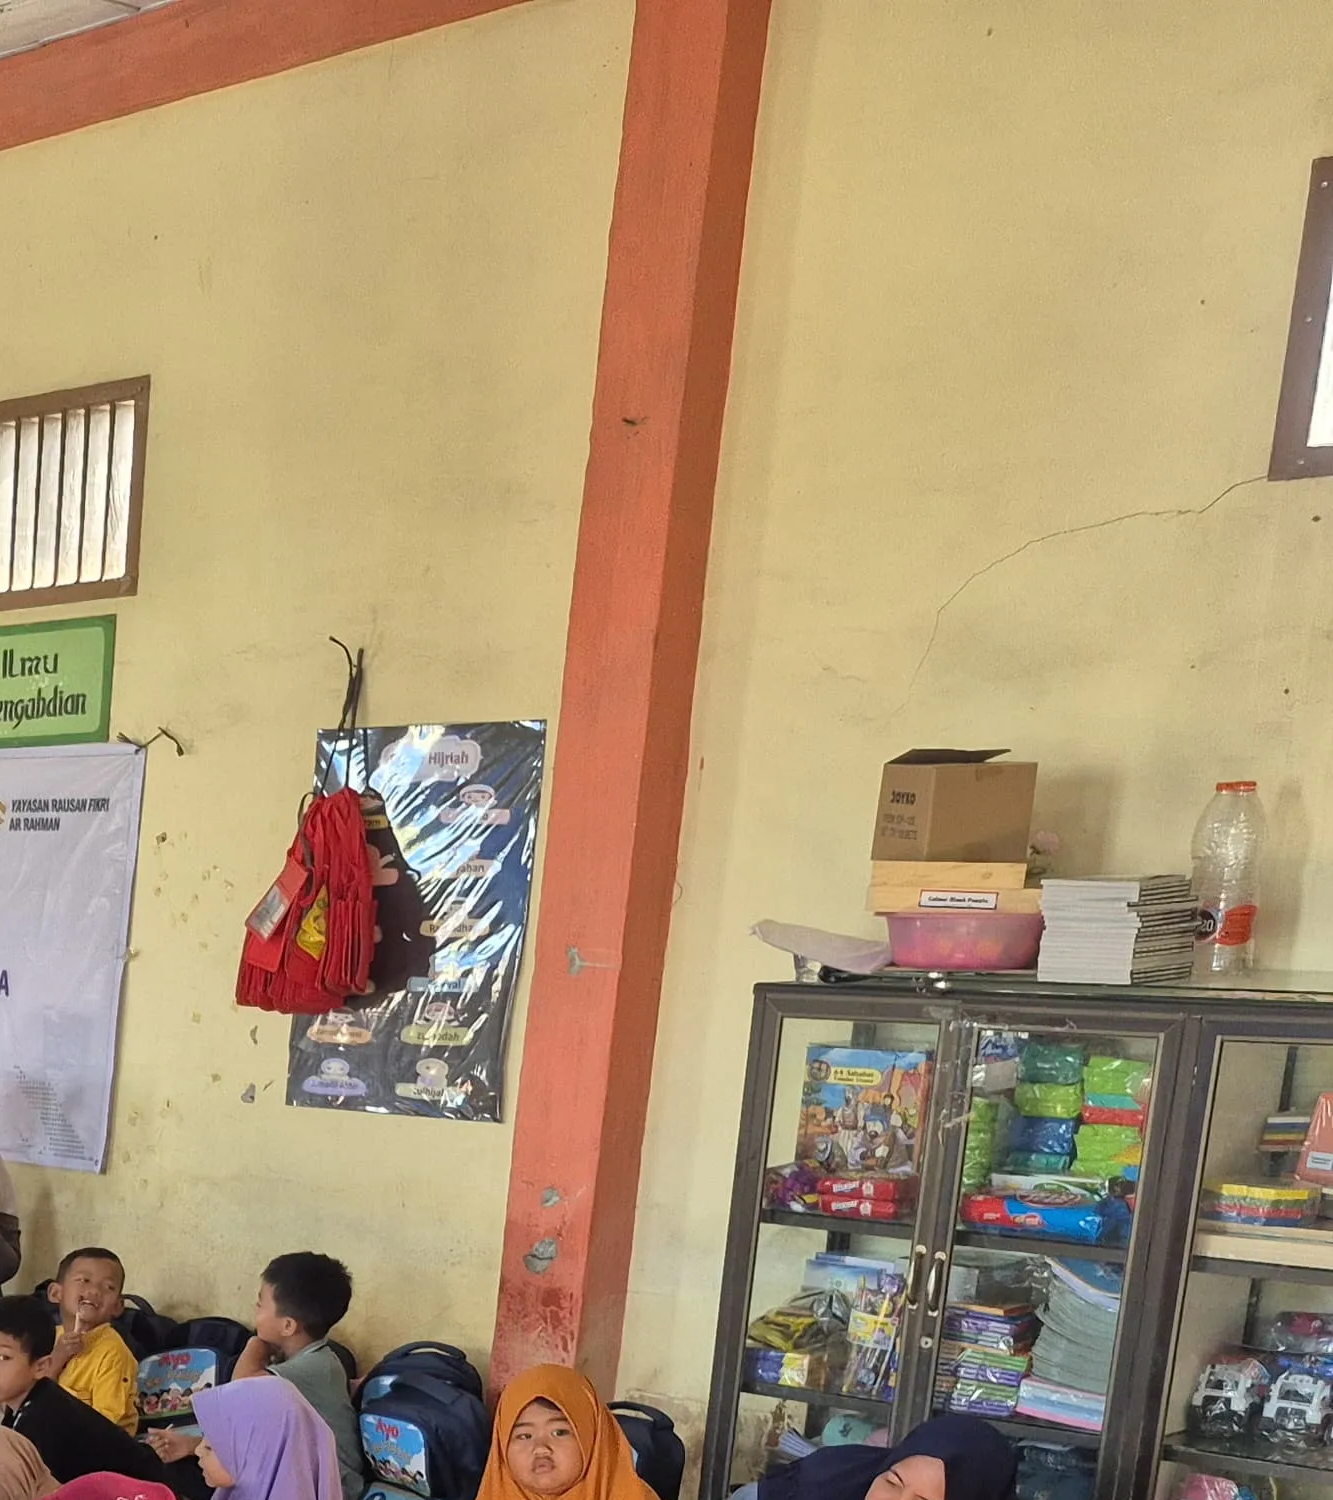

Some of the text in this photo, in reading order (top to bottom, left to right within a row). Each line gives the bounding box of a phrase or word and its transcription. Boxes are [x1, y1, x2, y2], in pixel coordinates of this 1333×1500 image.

[428, 750, 469, 767] Hijriah
[12, 798, 110, 812] YAYASAN RAUSAN FIKRI
[9, 817, 60, 831] AR RAHMAN
